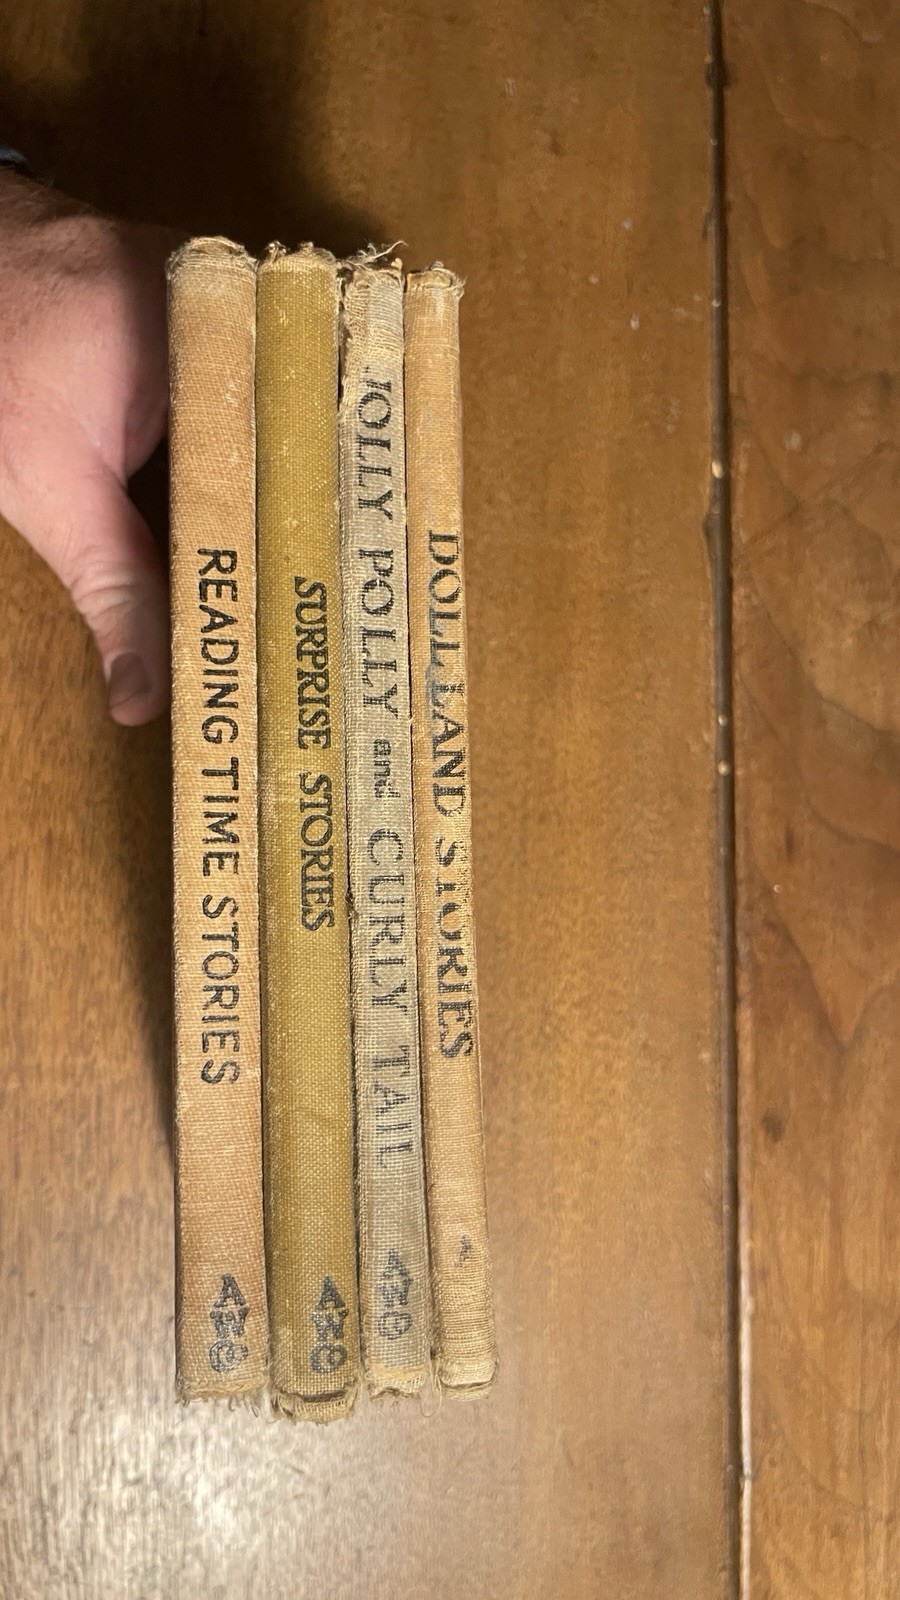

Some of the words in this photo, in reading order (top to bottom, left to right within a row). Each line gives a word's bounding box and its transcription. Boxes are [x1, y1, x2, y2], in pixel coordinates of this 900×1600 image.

[197, 548, 239, 744] READING
[294, 576, 332, 750] SURPRISE
[359, 549, 398, 719] POLLY
[428, 529, 462, 667] DOLL
[201, 756, 240, 876] TIME
[372, 738, 400, 799] and
[430, 682, 467, 818] LAND
[299, 771, 335, 932] STORIES
[366, 827, 407, 1016] CURLY
[201, 894, 240, 1085] STORIES
[435, 835, 476, 1059] STORIES
[372, 1043, 414, 1170] TAIL
